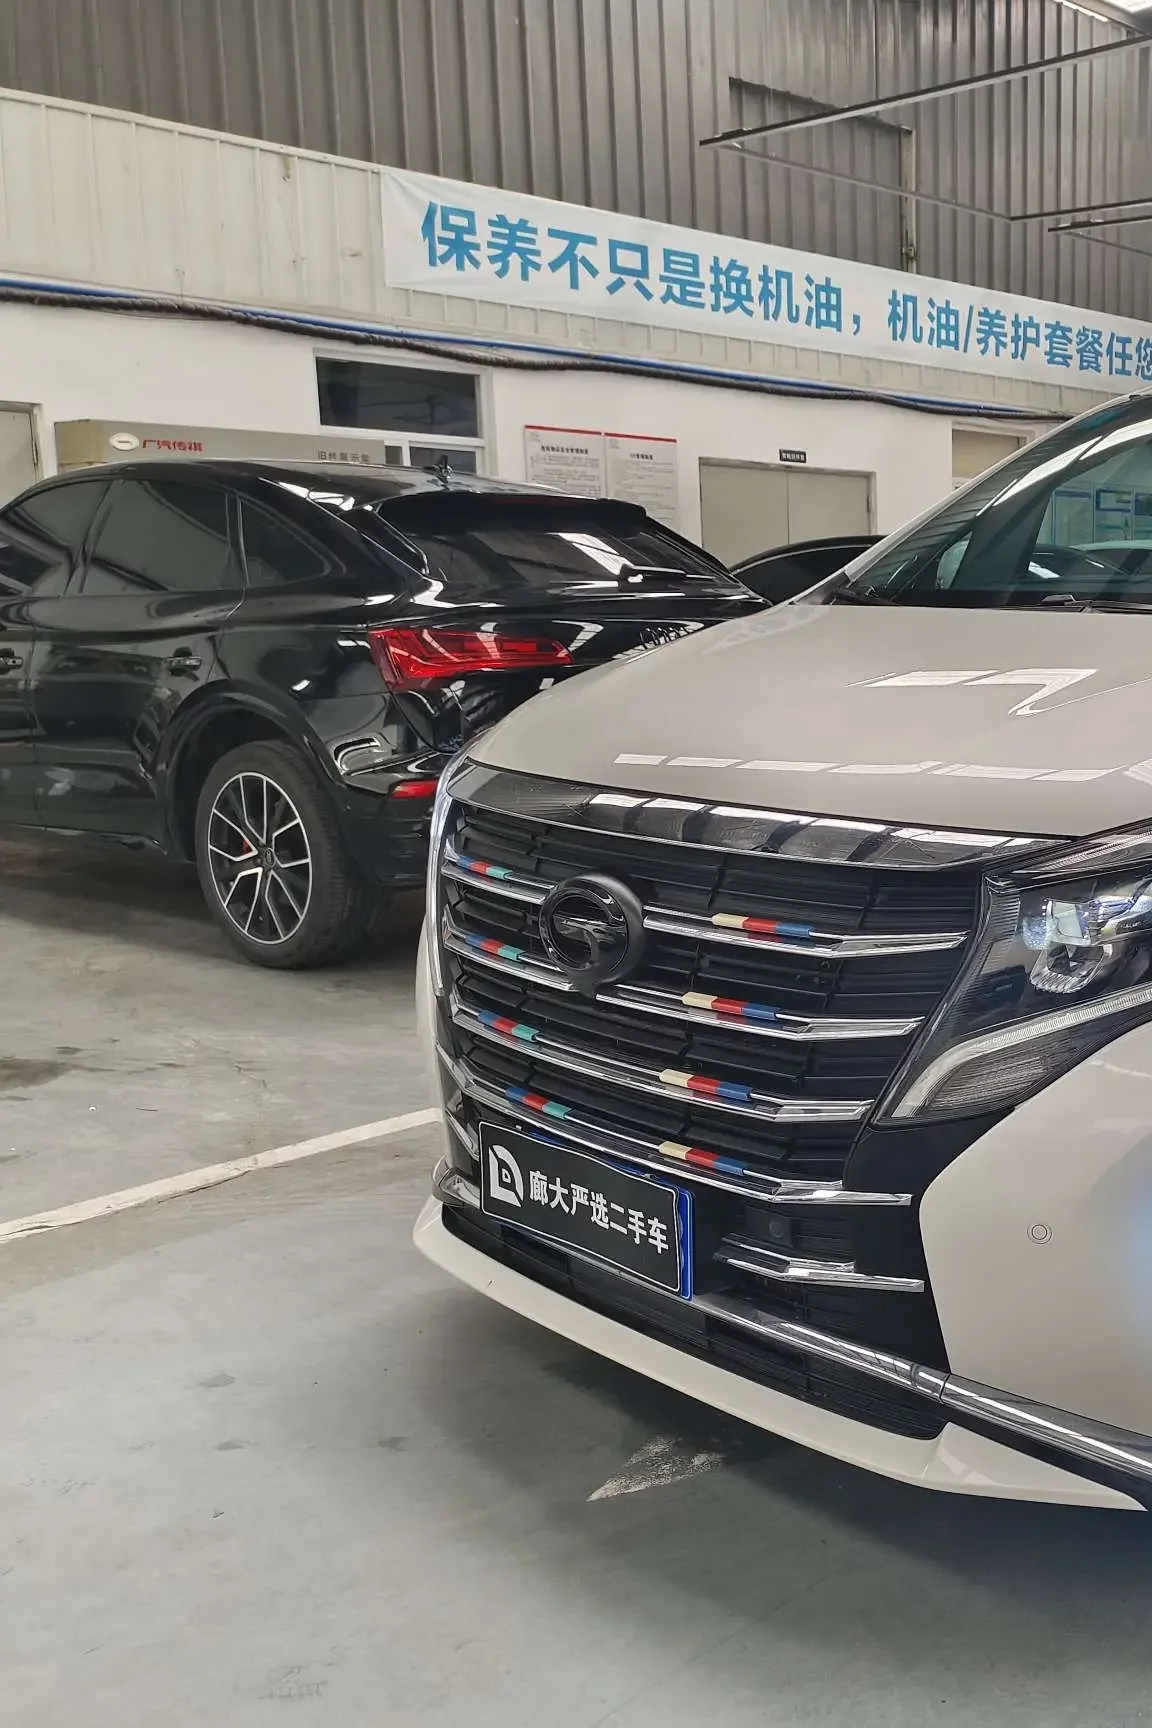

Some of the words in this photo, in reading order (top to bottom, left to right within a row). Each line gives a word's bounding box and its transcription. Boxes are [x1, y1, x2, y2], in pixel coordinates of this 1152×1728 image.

[529, 1170, 669, 1255] 廊大严选二手车
